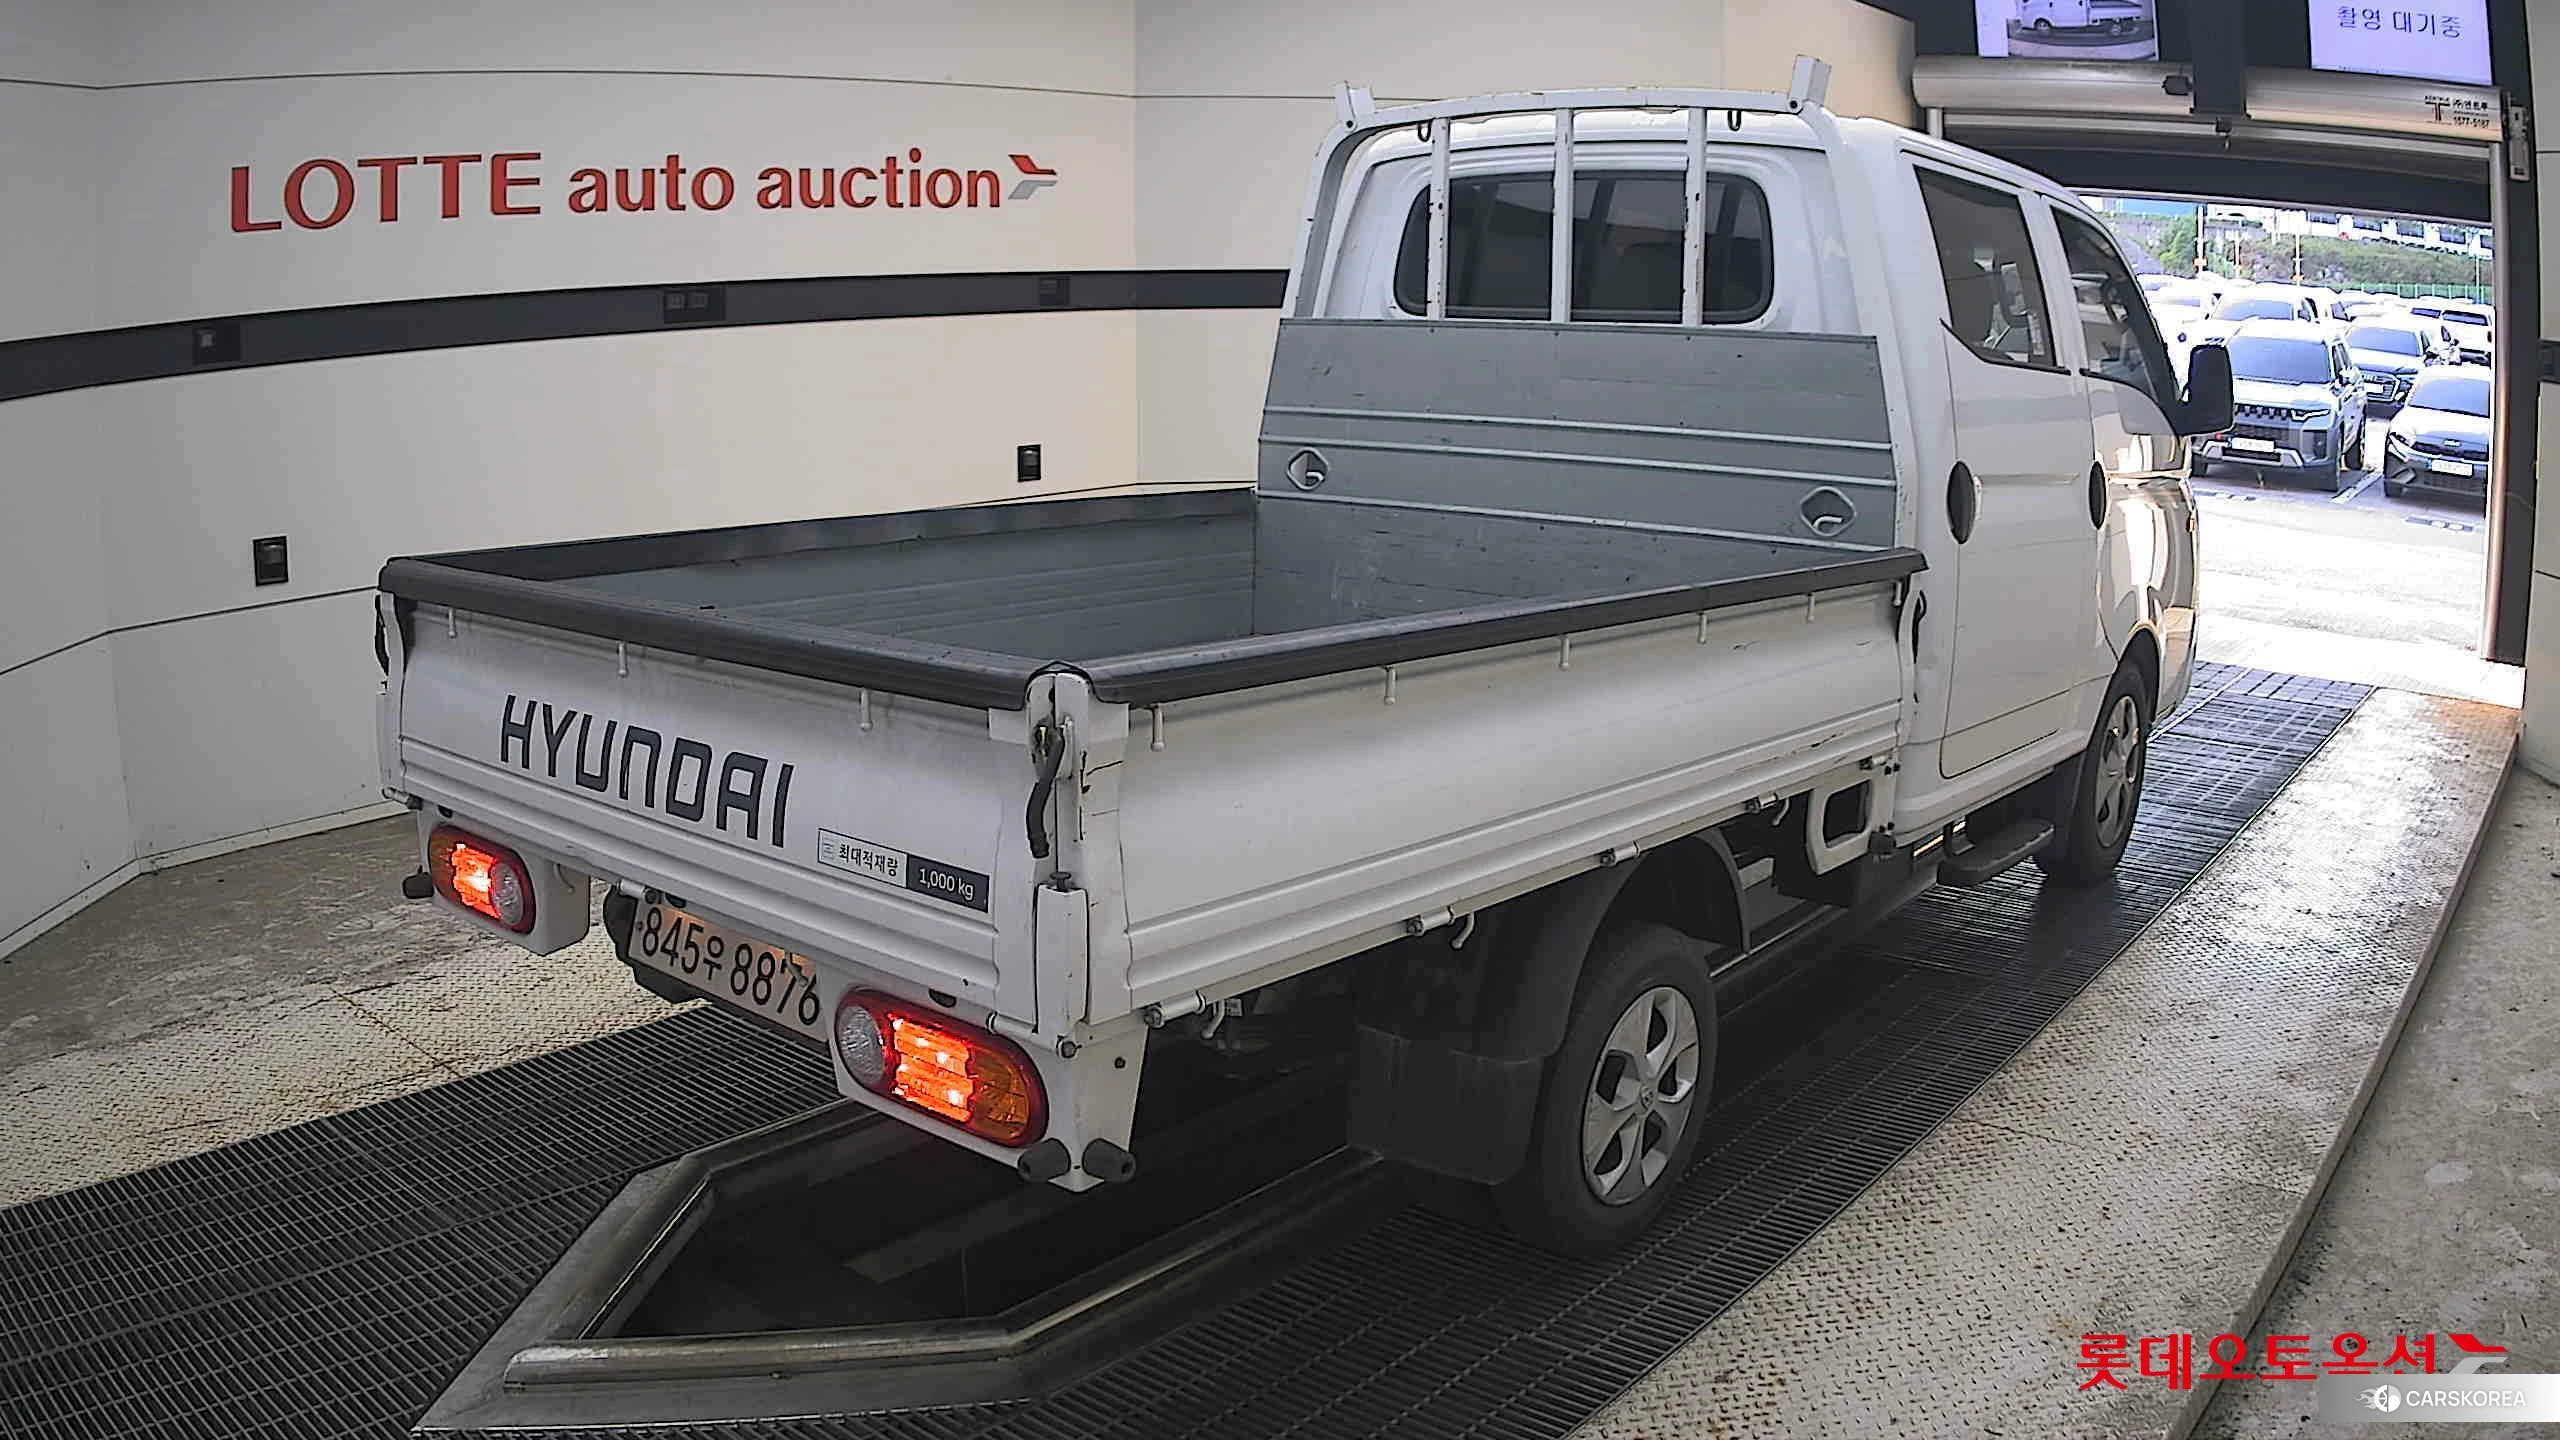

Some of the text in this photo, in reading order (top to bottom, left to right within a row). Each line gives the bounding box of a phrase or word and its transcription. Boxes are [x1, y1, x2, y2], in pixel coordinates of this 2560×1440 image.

[2338, 6, 2462, 39] 촬영 대기중
[231, 148, 1002, 232] LOTTE auto auction
[500, 694, 795, 849] HYUNDAI
[839, 843, 898, 877] 최대적재량
[918, 867, 955, 892] 1,000
[957, 878, 974, 901] kg
[642, 906, 725, 980] 845우
